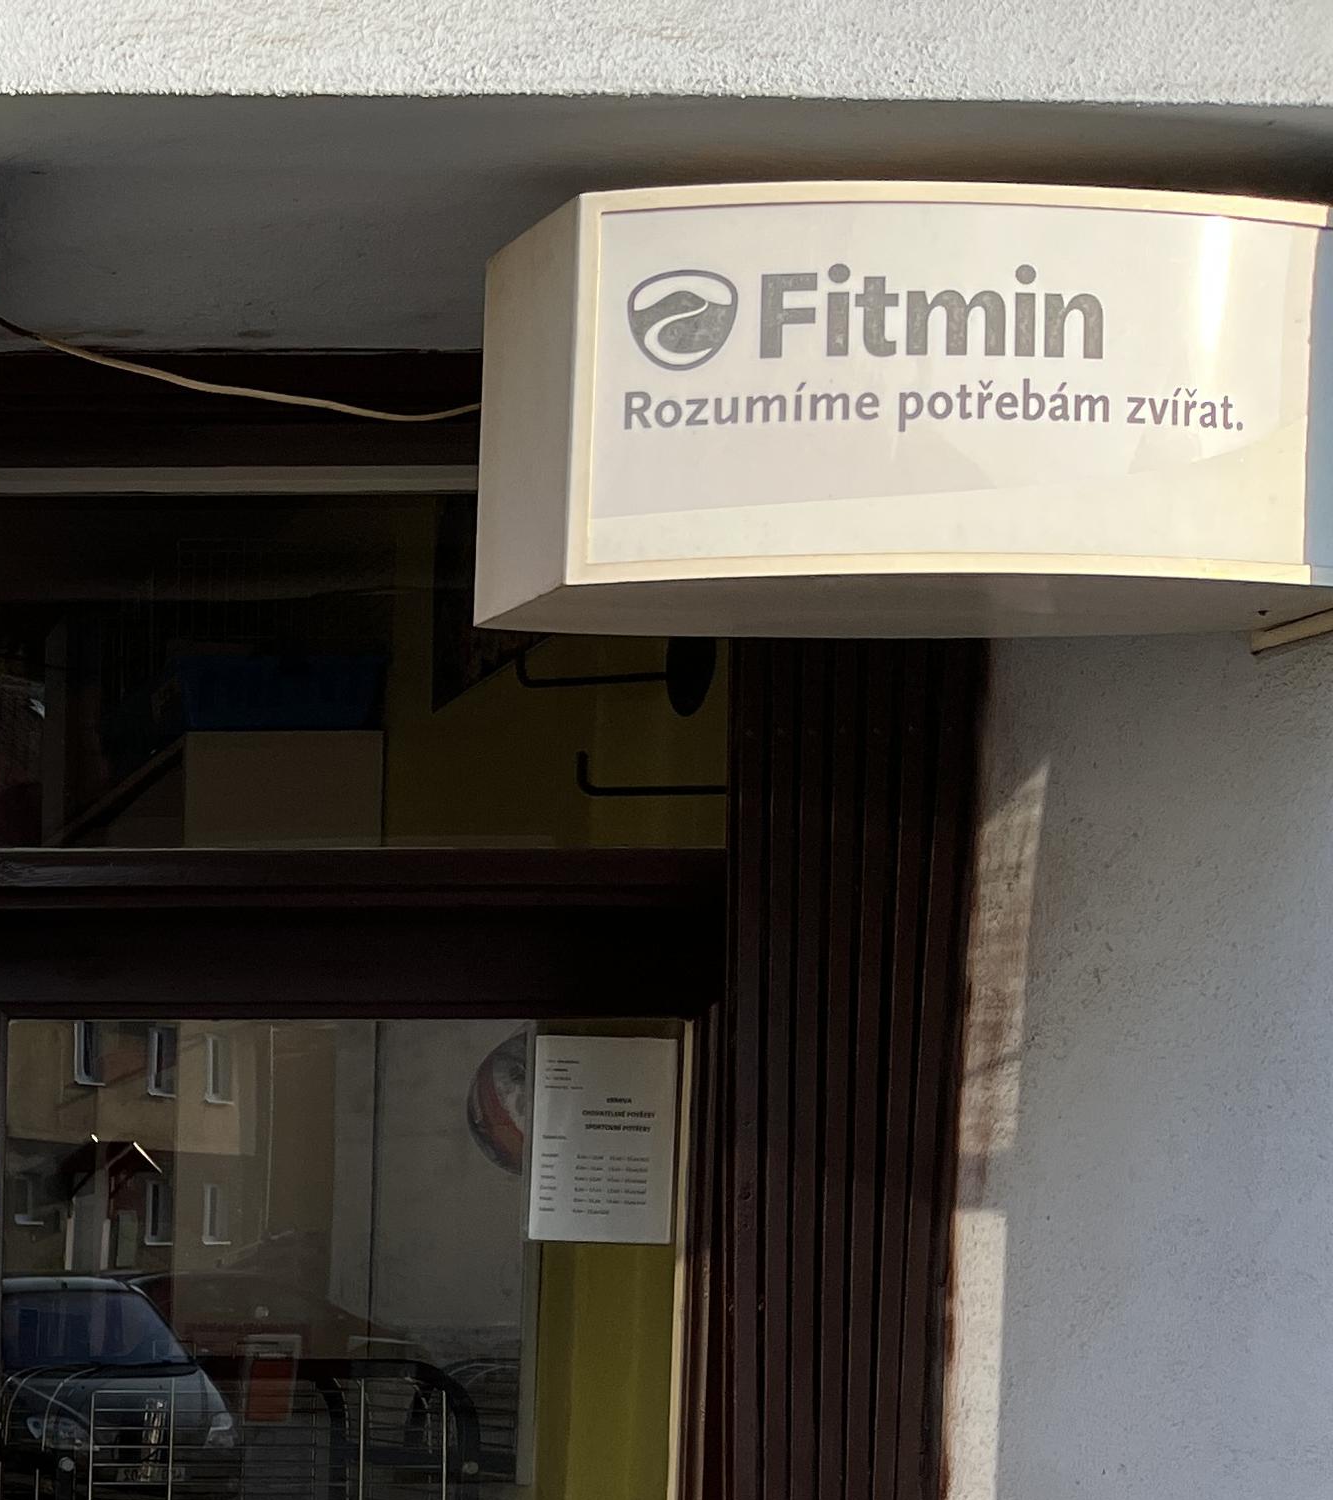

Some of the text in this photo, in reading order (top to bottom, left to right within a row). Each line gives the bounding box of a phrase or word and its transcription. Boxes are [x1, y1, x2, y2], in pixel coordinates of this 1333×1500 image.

[758, 262, 1106, 360] Fitmin
[623, 379, 1246, 432] Rozumíme potřebám zvířat.
